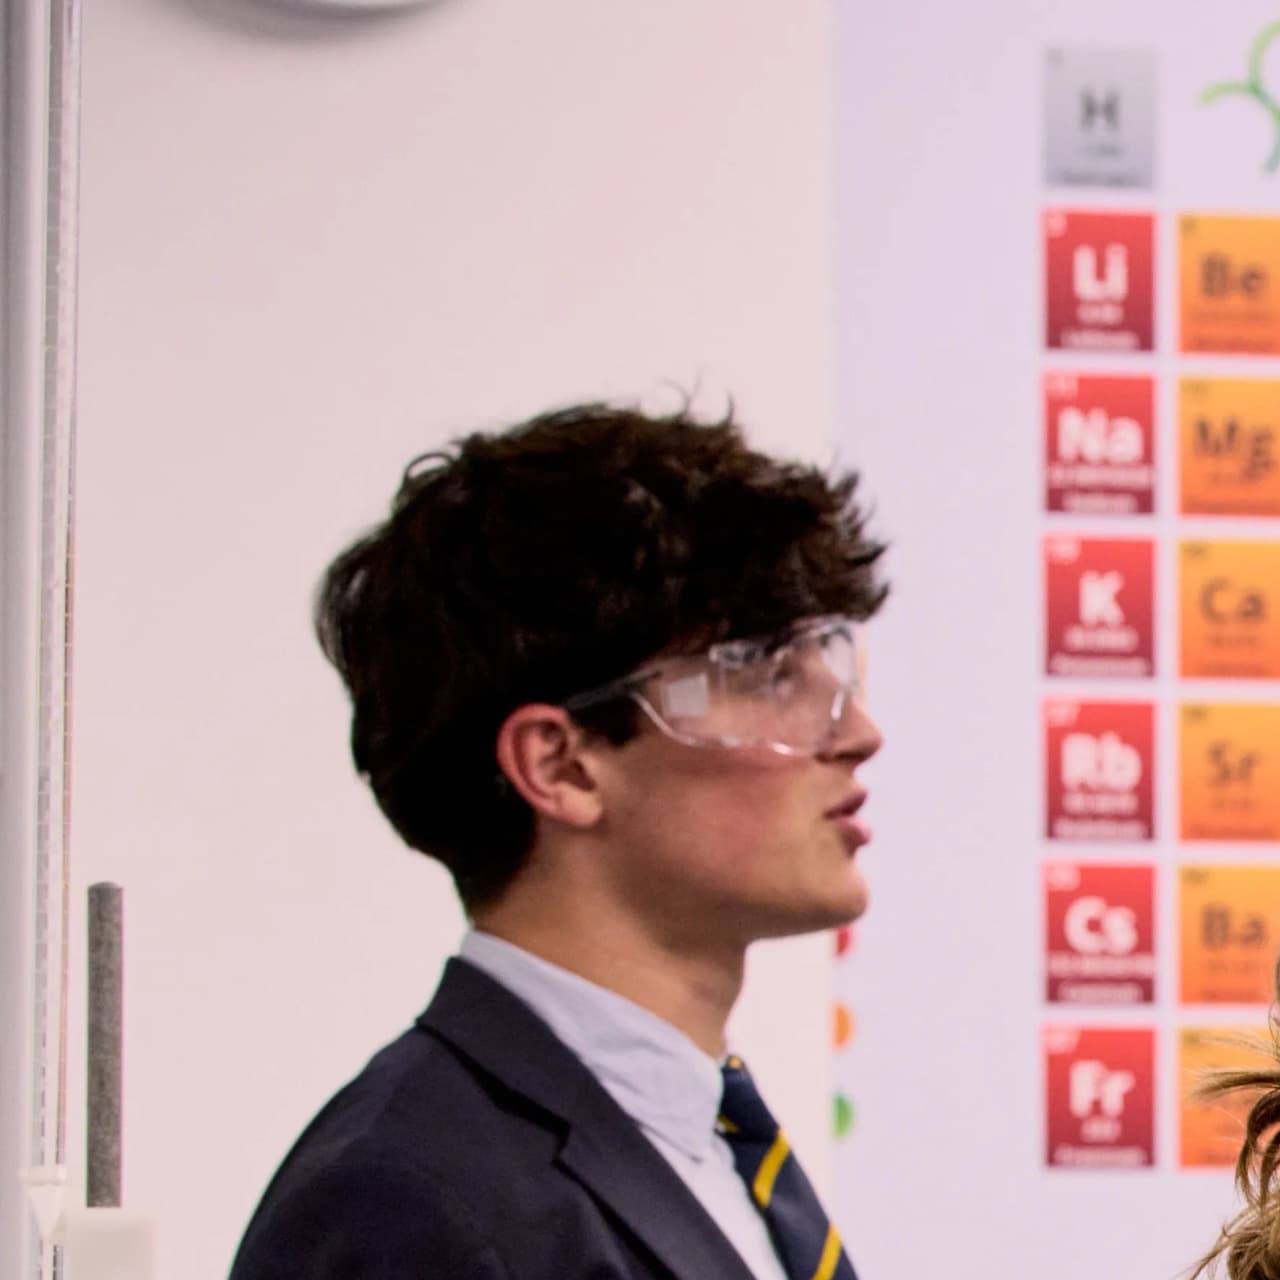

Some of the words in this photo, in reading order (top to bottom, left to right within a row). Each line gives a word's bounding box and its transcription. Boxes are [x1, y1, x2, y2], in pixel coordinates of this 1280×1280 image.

[1080, 90, 1118, 132] H
[1200, 254, 1268, 298] Be
[1057, 409, 1144, 465] Na
[1195, 418, 1275, 481] Mg
[1079, 570, 1122, 626] K
[1200, 579, 1266, 624] Ca
[1061, 731, 1142, 792] Rb
[1209, 743, 1258, 788] Sr
[1064, 897, 1137, 954] Cs
[1201, 906, 1267, 951] Ba
[1069, 1060, 1134, 1118] Fr
